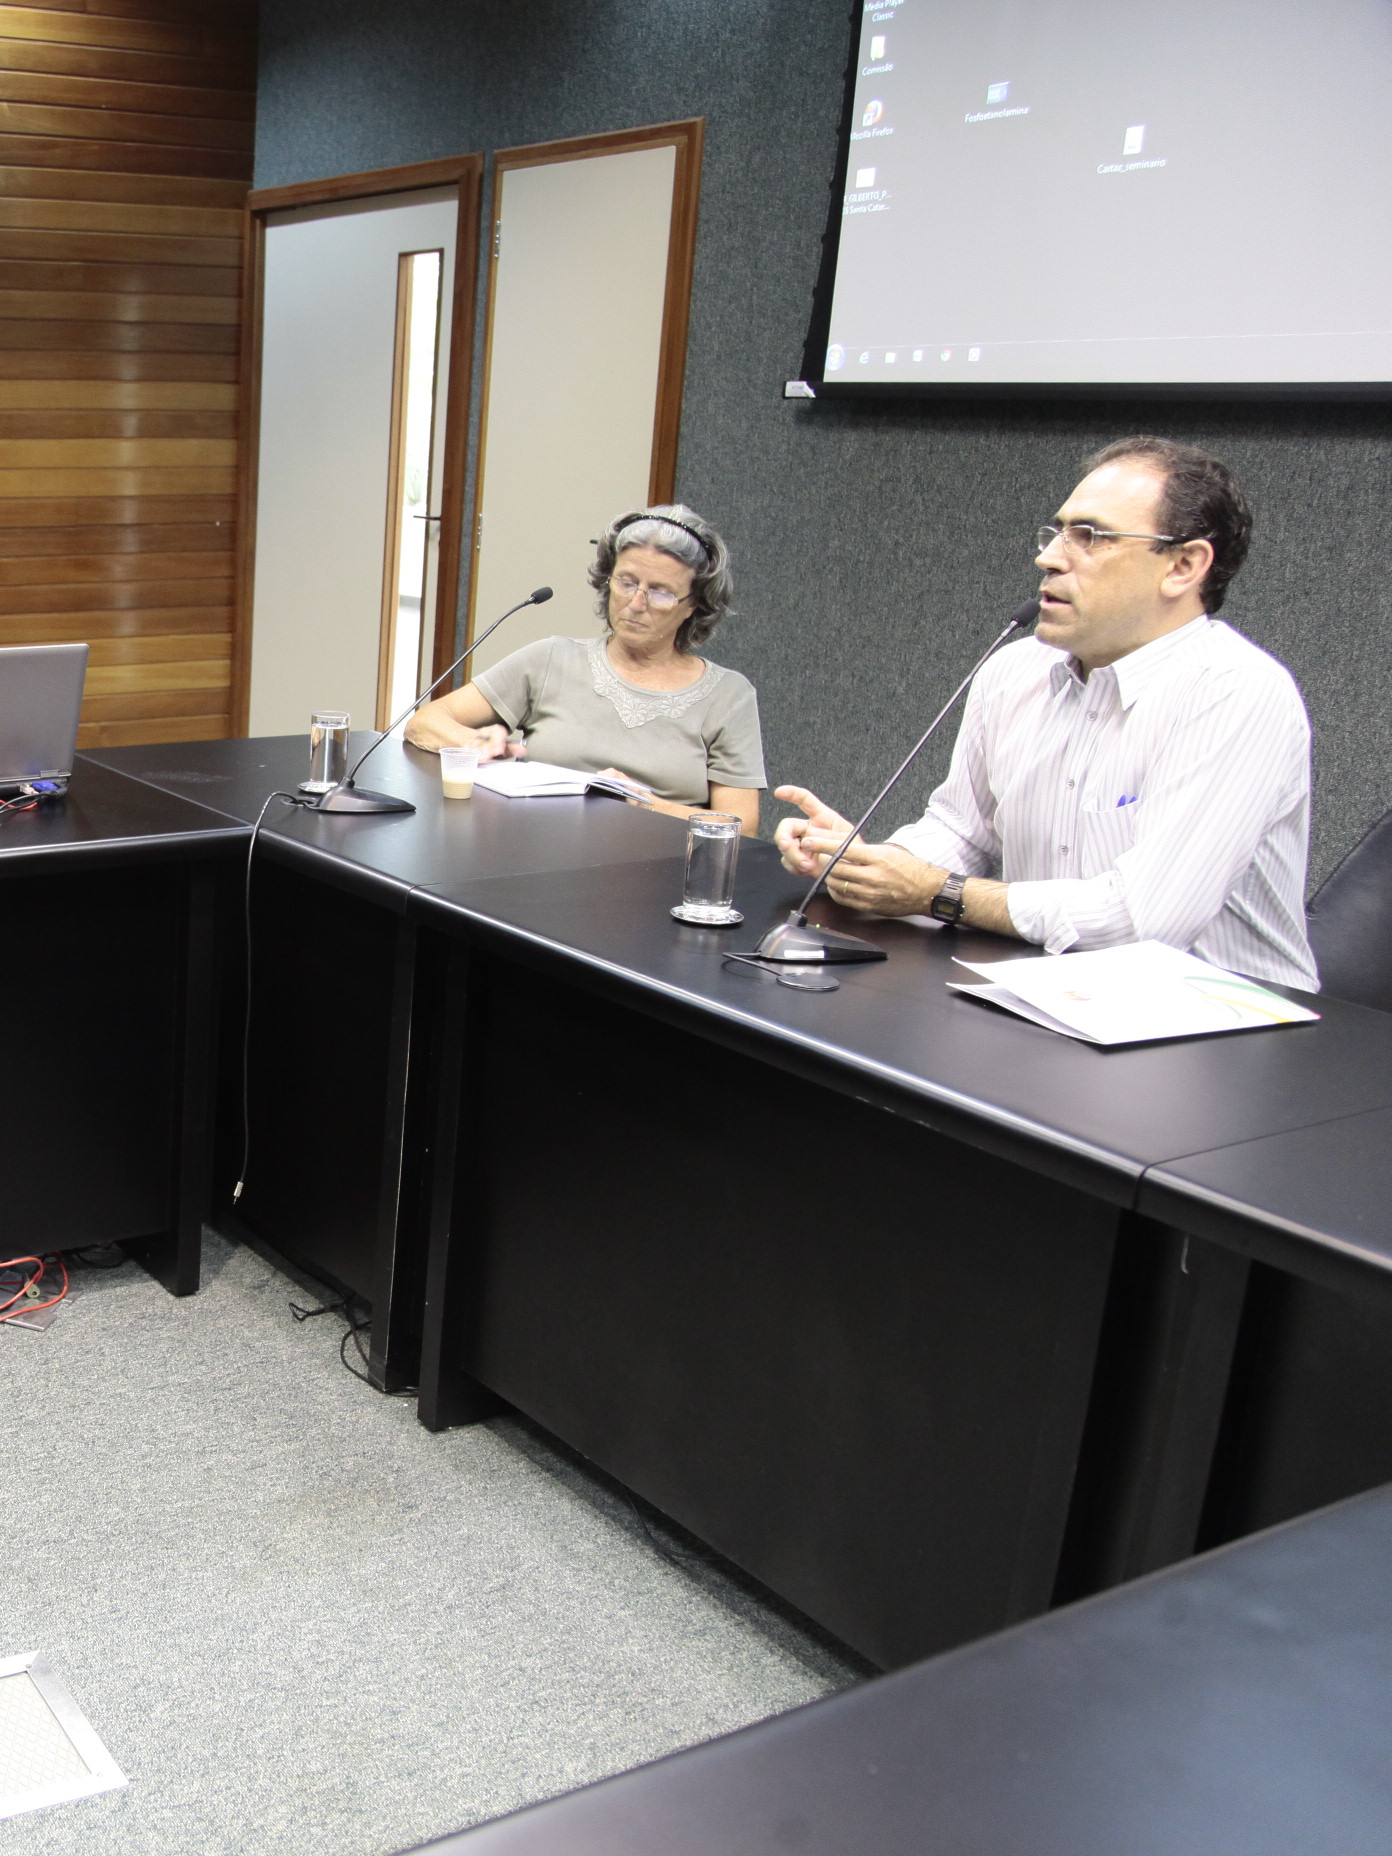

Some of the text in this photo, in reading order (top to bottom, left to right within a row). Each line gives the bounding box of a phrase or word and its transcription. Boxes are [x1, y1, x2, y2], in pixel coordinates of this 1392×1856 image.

[872, 11, 894, 22] Classic
[964, 106, 1030, 123] Fosfoetanolamina
[850, 126, 895, 141] Mozilla Firefox
